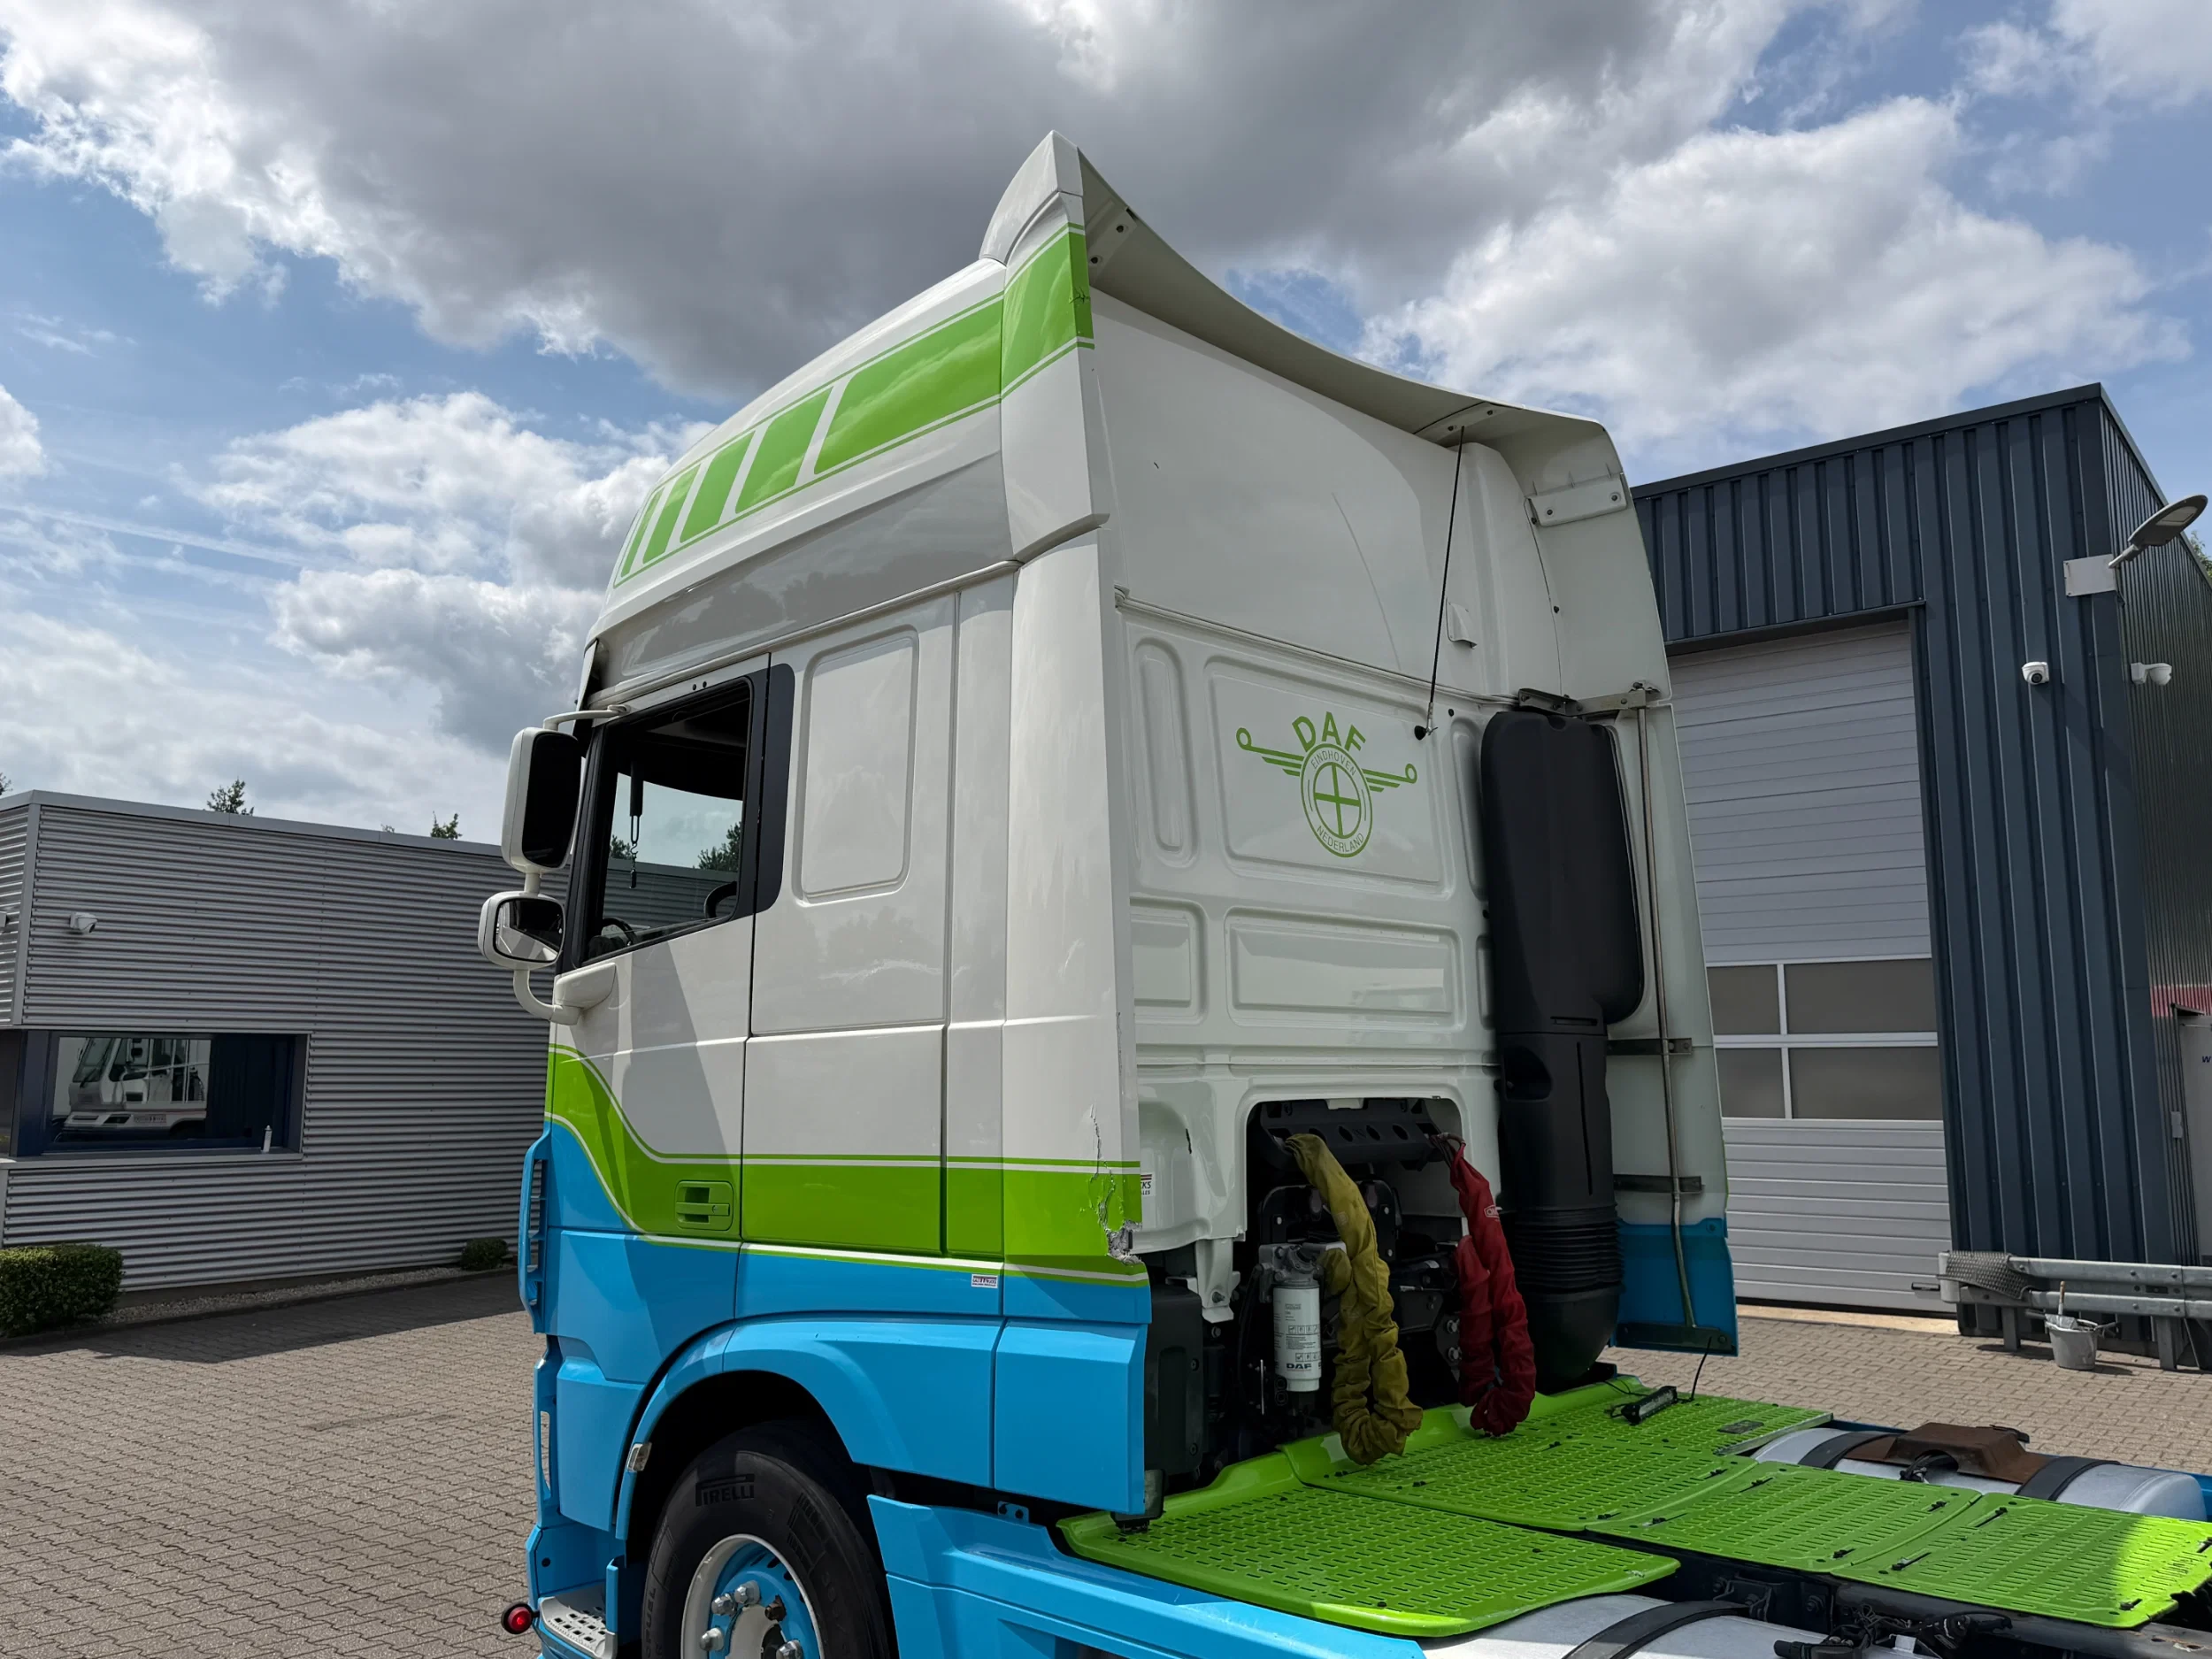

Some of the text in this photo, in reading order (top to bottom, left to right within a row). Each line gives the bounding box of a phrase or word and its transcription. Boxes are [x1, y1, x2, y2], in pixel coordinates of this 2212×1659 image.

[1292, 711, 1366, 752] DAF
[1310, 750, 1356, 776] EINDHOVEN
[1317, 825, 1364, 852] NEDERLAND
[695, 1473, 755, 1507] PIRELLI
